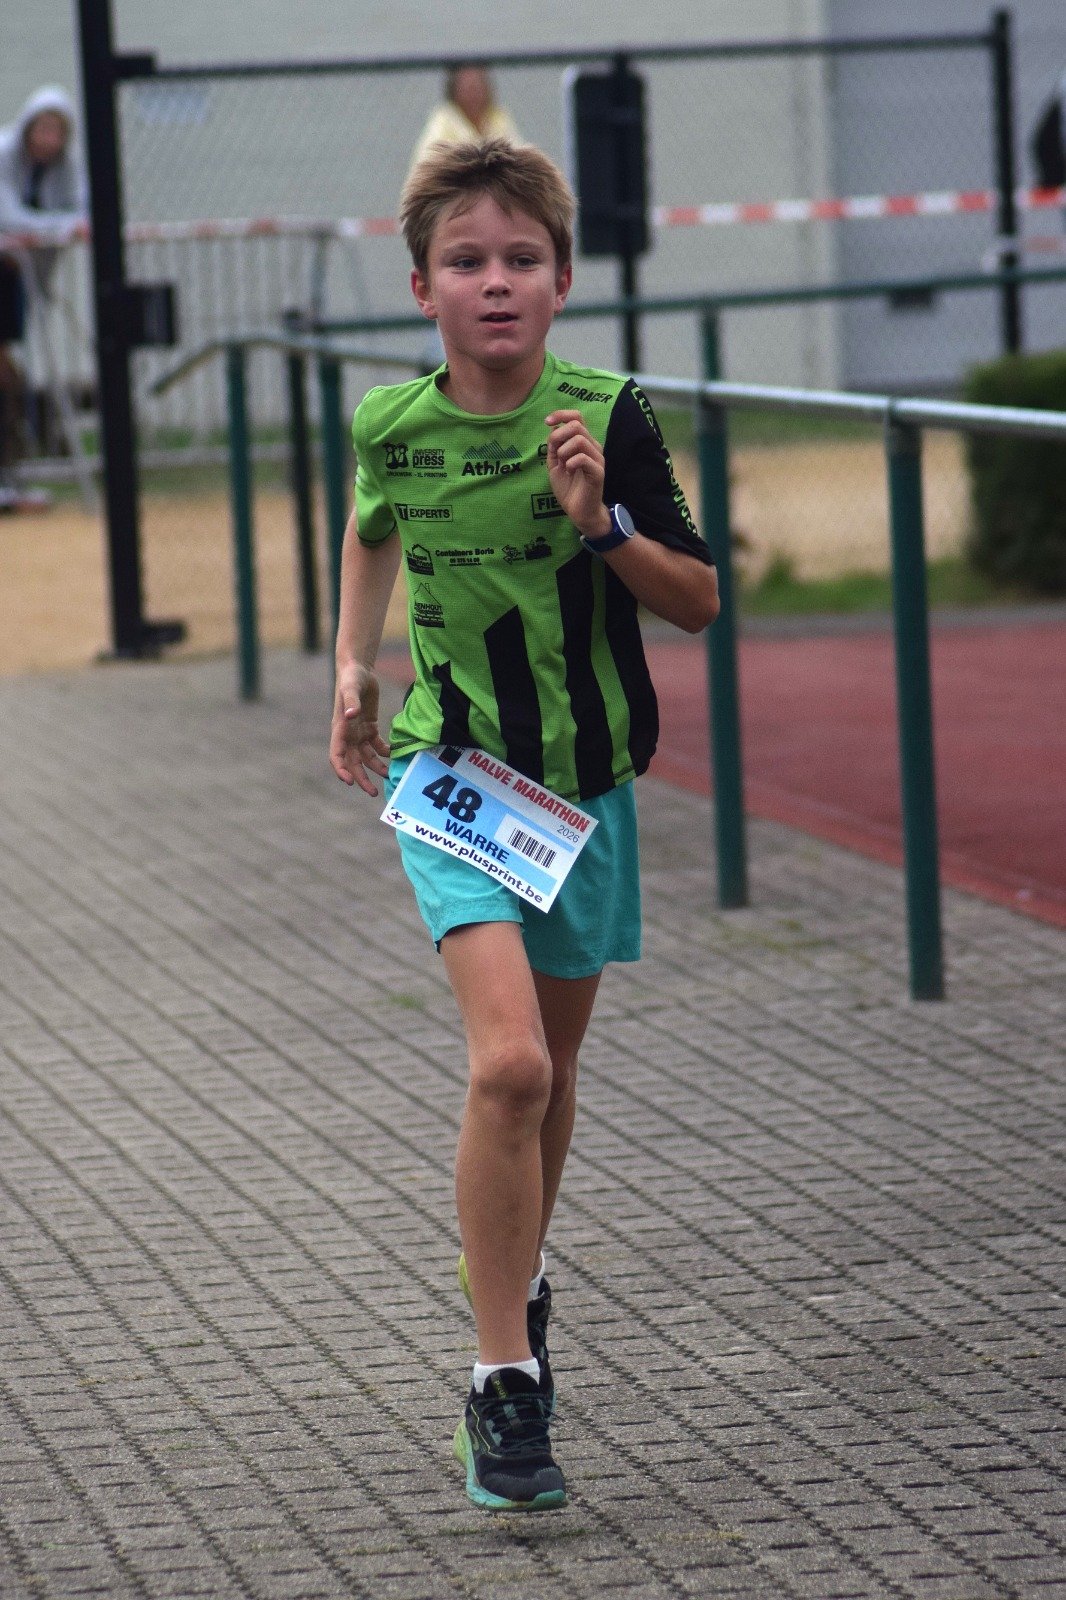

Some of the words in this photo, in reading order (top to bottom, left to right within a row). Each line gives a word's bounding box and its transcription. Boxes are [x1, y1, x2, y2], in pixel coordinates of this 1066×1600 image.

[557, 381, 613, 403] BIORACER
[413, 455, 445, 468] press
[461, 460, 522, 476] Athlex
[410, 509, 450, 518] EXPERTS
[435, 549, 473, 557] Containers
[422, 774, 483, 823] 48
[468, 751, 514, 785] HALVE
[512, 778, 590, 833] MARATHON
[445, 819, 510, 864] WARRE
[557, 825, 580, 843] 2026
[415, 824, 543, 904] www.plusprint.be
